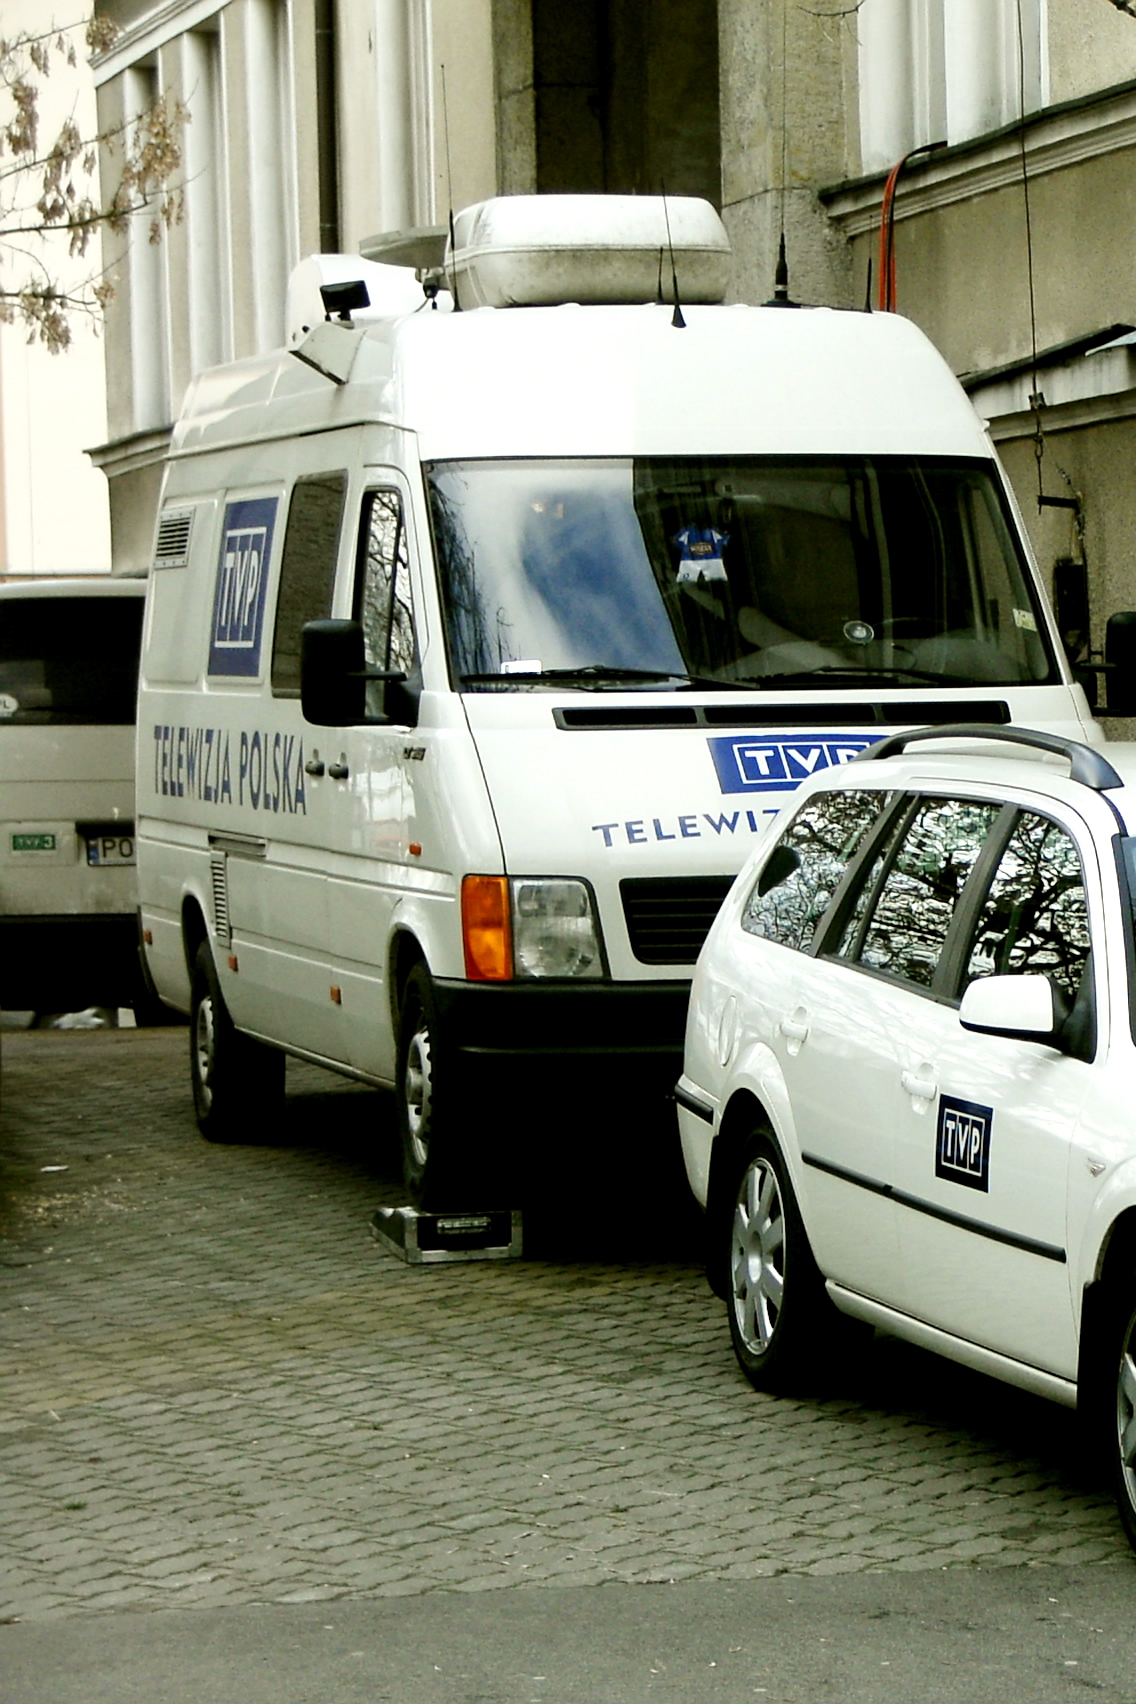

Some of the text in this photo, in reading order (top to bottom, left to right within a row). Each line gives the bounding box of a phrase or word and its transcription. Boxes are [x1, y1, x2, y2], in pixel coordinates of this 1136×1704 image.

[221, 550, 260, 626] TVP
[154, 725, 307, 815] TELEWIZJA POLSKA
[945, 1119, 981, 1165] TVP
